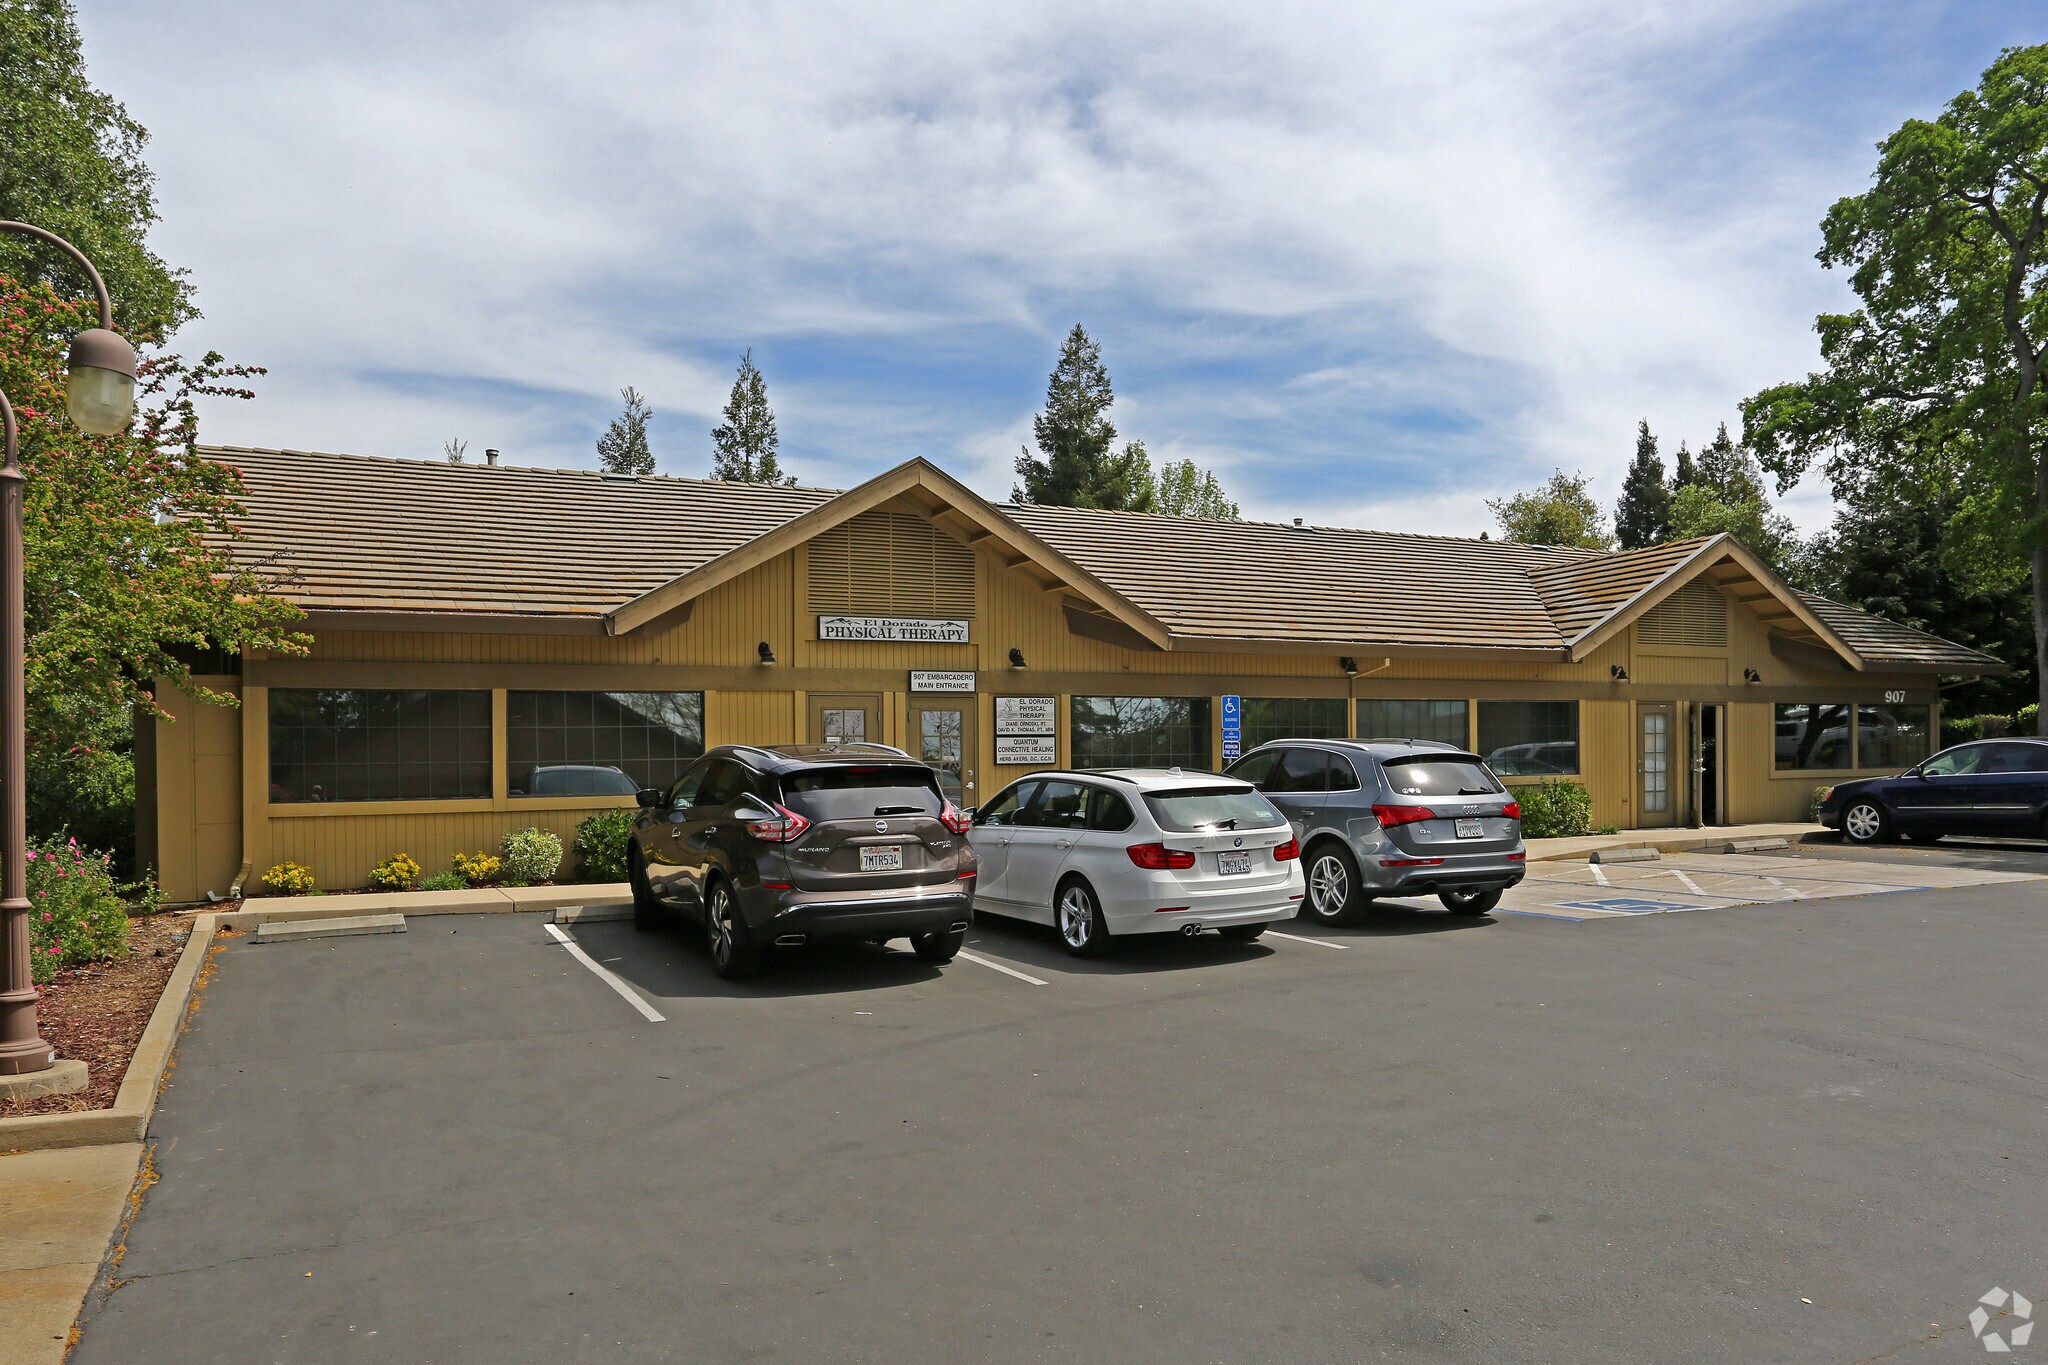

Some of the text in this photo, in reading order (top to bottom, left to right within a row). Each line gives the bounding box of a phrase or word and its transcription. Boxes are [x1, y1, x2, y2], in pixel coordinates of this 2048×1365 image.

[864, 619, 928, 628] El Dorado
[825, 626, 964, 641] PHYSICAL THERAPY
[935, 682, 969, 690] ENTRANCE
[1885, 690, 1906, 703] 907
[863, 855, 898, 866] 7MTR534
